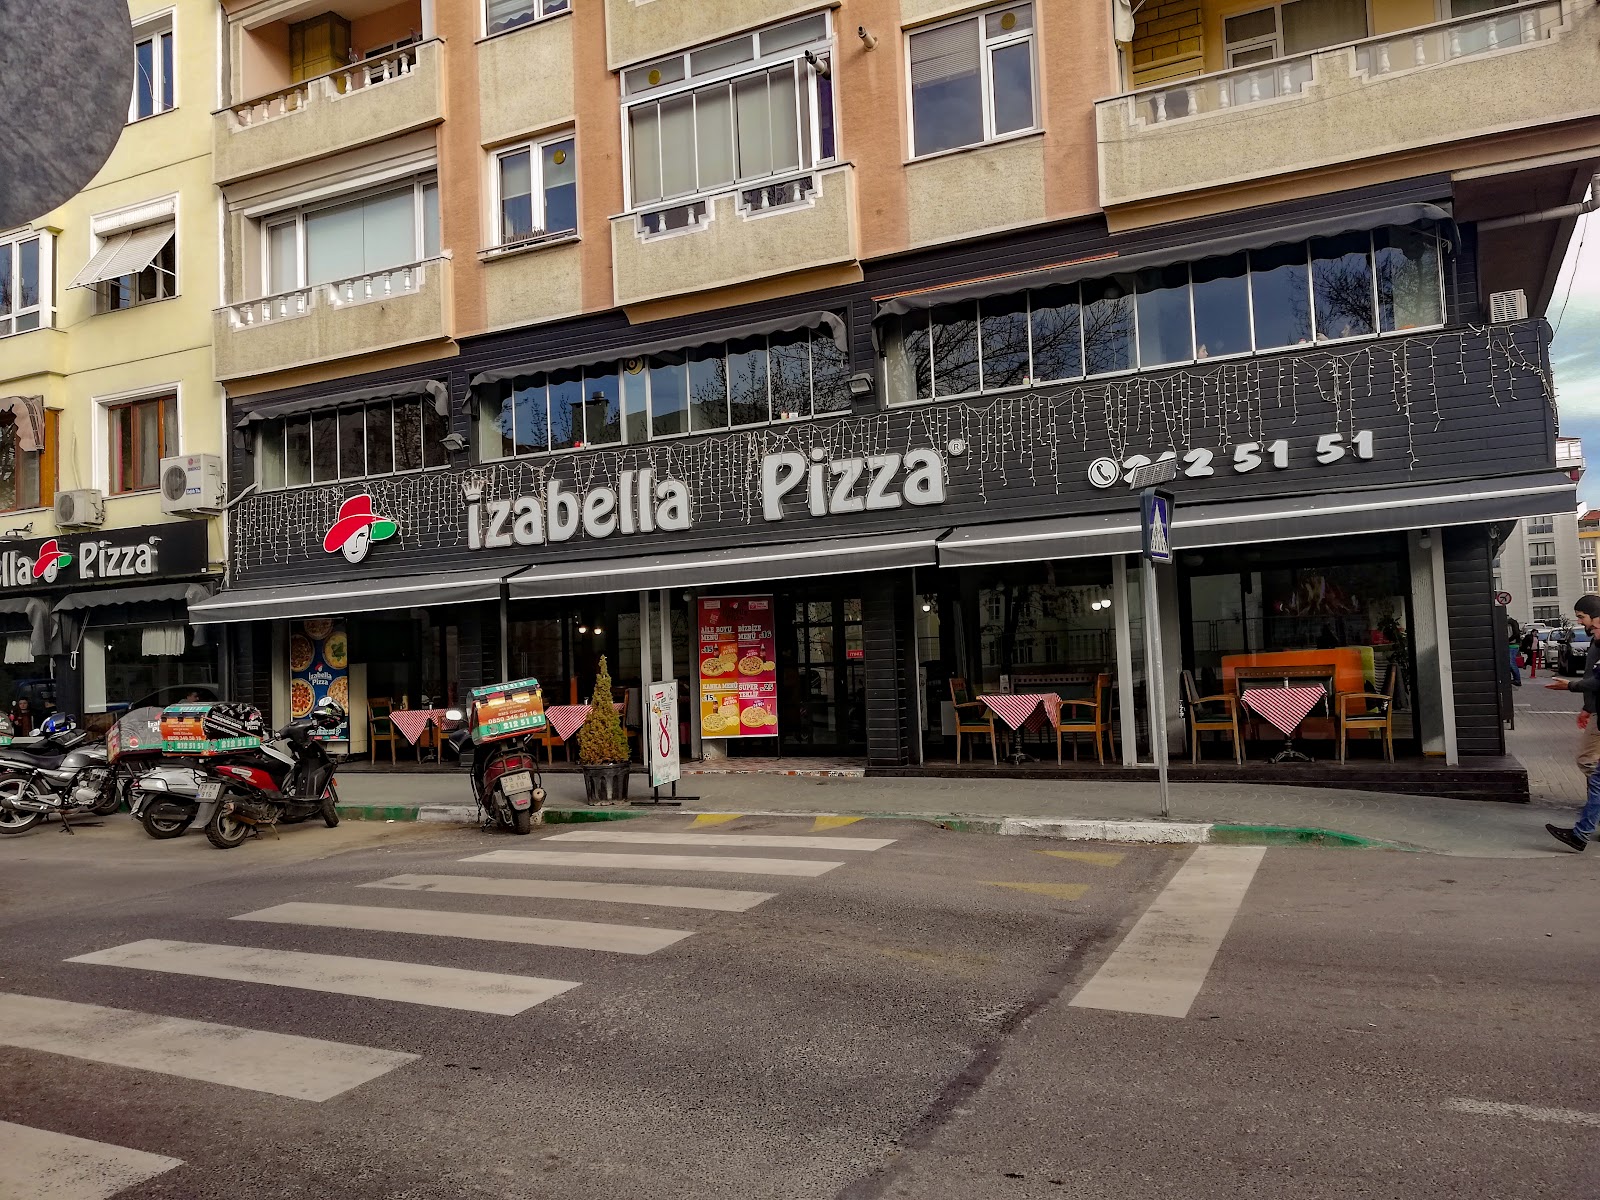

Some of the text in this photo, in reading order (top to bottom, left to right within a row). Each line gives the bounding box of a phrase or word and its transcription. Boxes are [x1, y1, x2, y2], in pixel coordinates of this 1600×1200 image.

[1234, 439, 1289, 473] 51
[1316, 430, 1373, 464] 51
[761, 447, 947, 522] Pizza
[0, 540, 152, 587] lla Pizza
[221, 740, 235, 748] 212
[503, 721, 518, 729] 212
